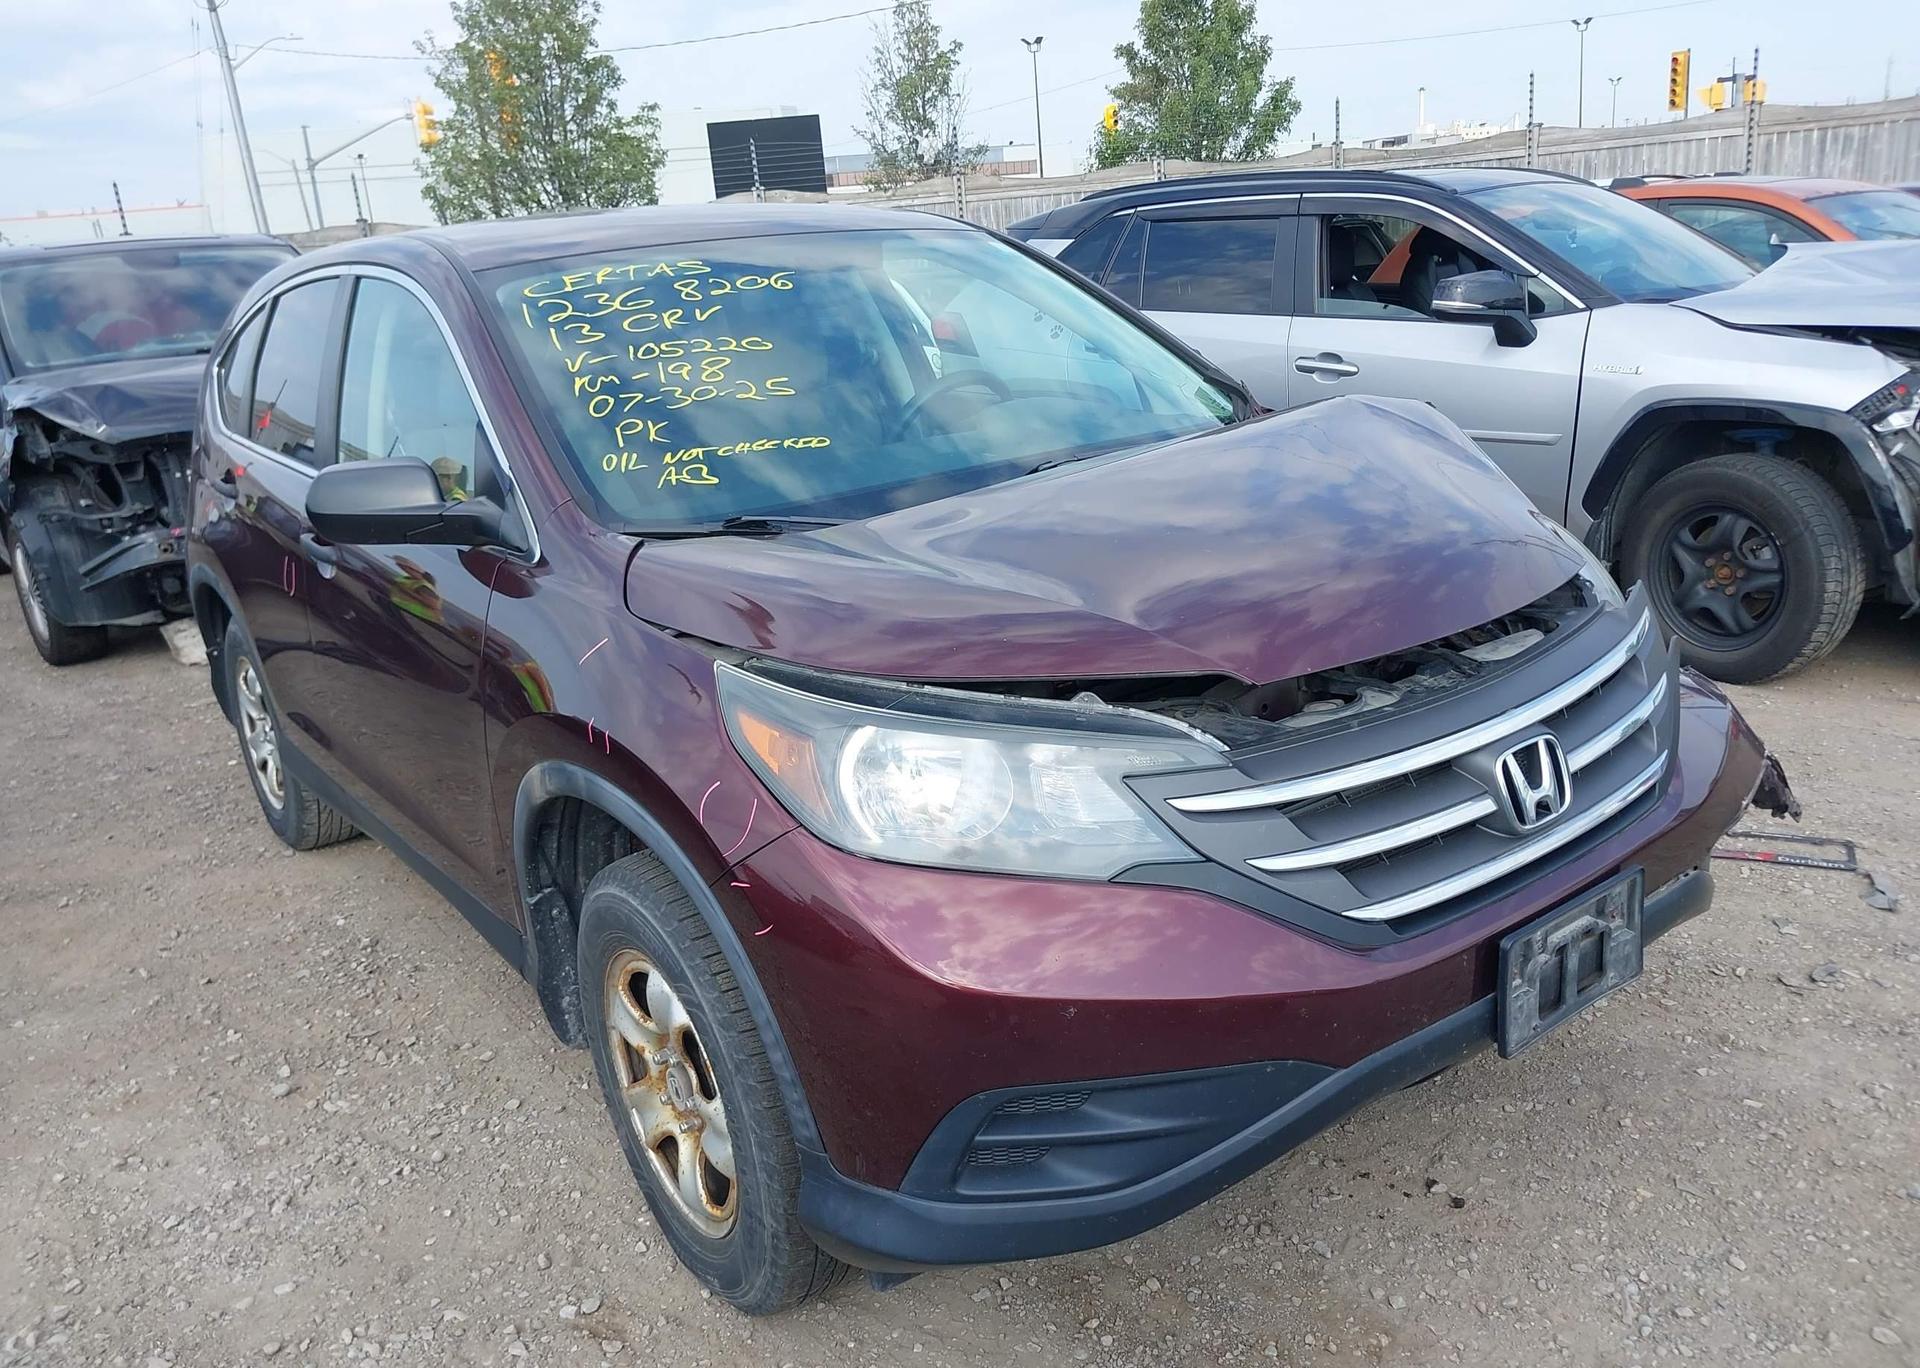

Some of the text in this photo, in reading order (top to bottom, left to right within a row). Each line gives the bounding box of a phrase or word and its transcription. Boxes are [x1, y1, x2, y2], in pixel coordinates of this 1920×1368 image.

[523, 261, 711, 298] CERTAS
[522, 271, 795, 328] 1236 8206
[550, 305, 723, 351] 13 CRV
[588, 377, 797, 417] 07-30-25
[615, 418, 671, 447] PK
[602, 452, 648, 473] OIL
[663, 446, 719, 465] NOT
